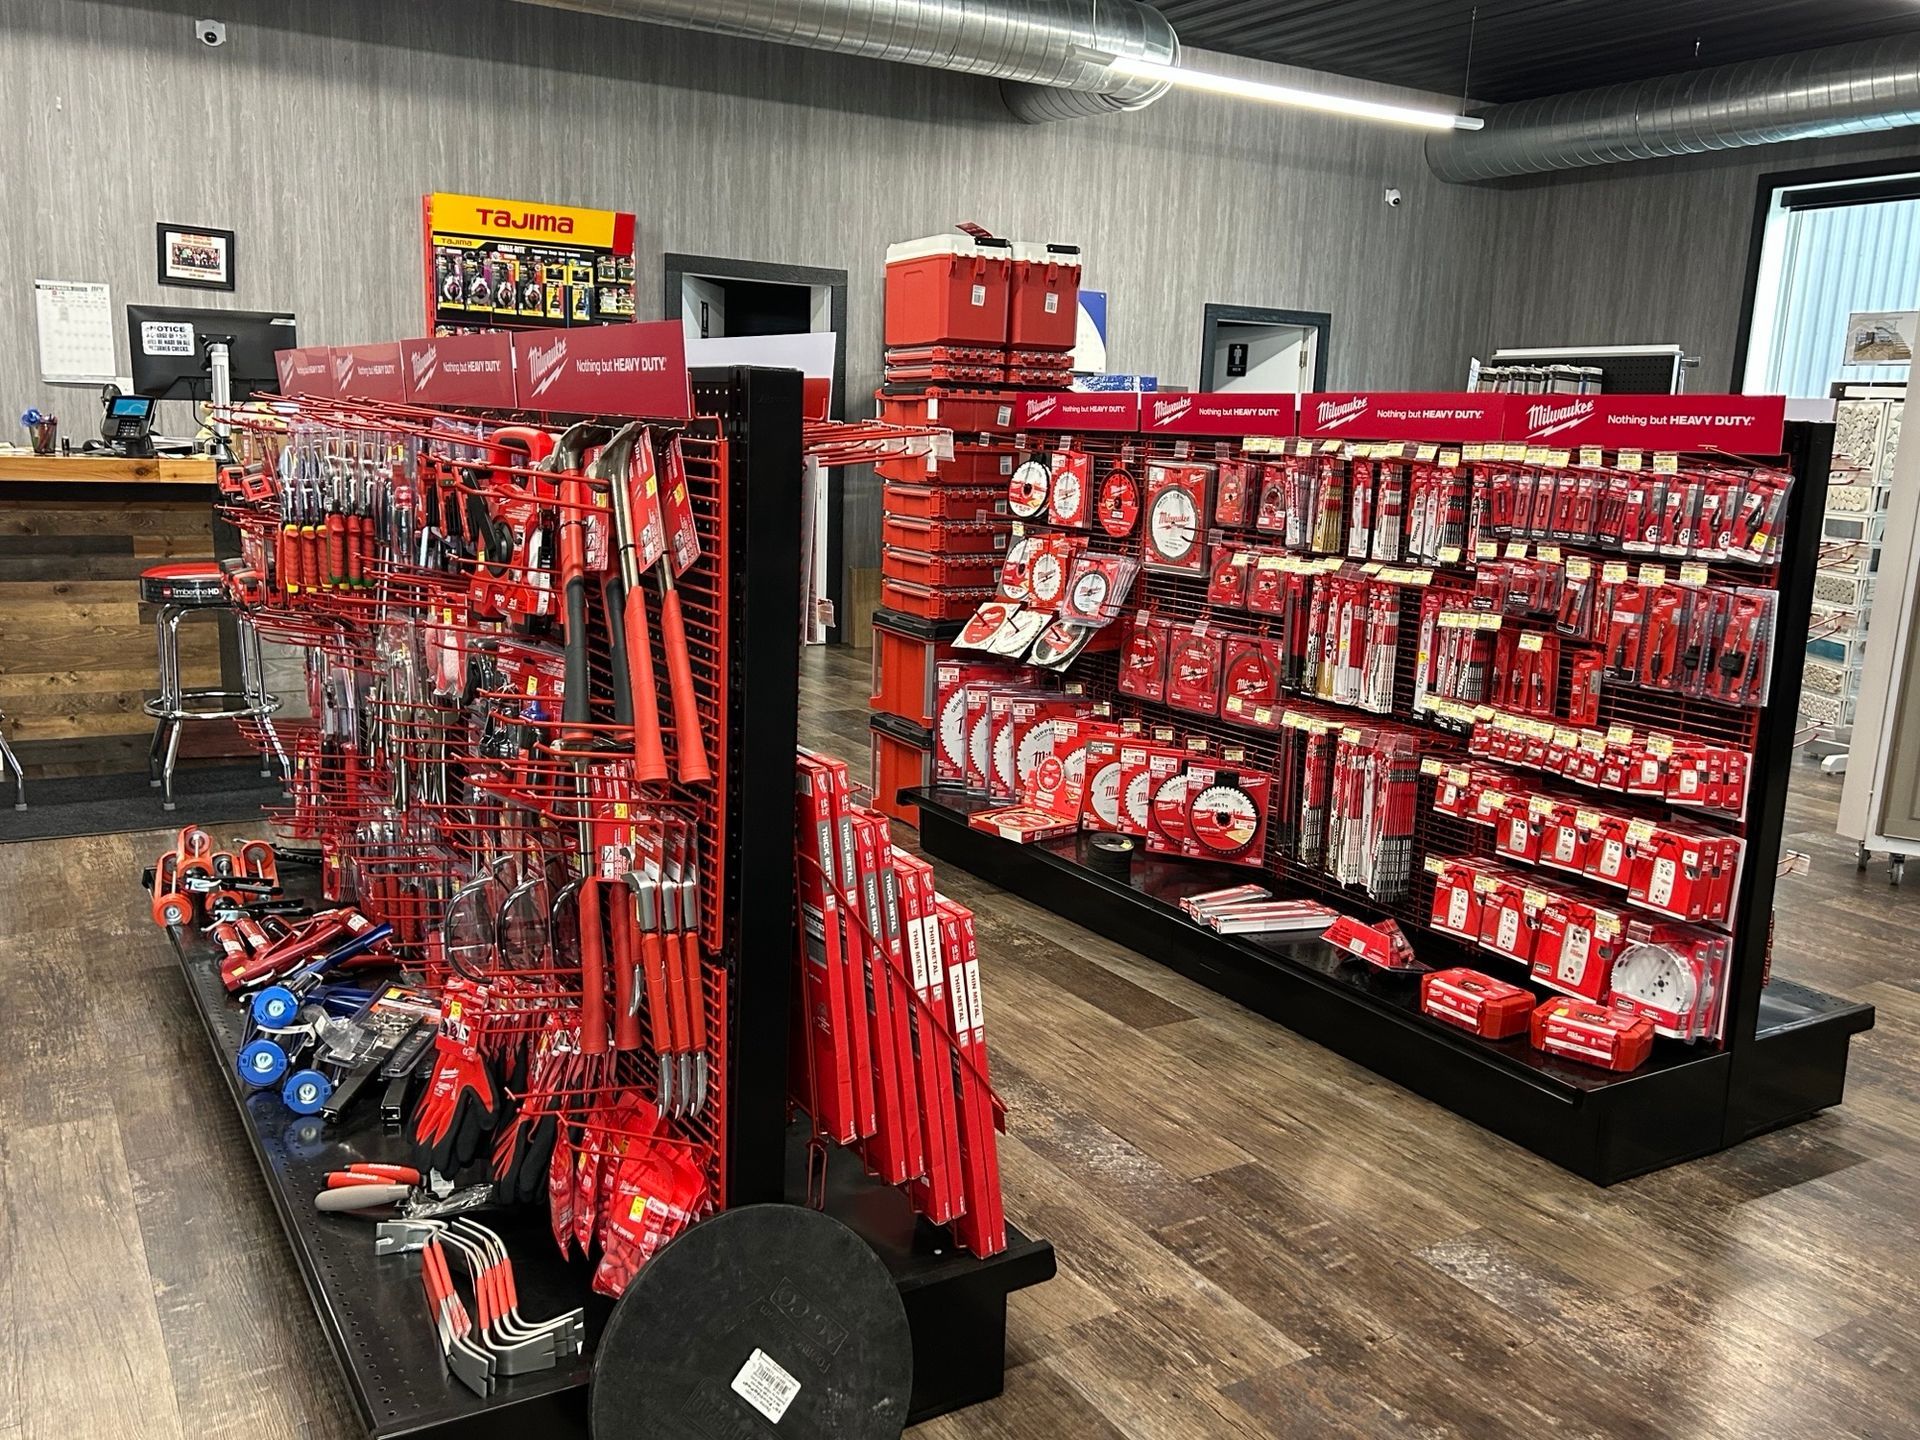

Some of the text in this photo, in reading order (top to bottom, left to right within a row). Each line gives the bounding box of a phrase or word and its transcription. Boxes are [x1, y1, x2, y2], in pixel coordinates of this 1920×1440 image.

[468, 361, 484, 372] HEAVY
[576, 359, 601, 376] Nothing
[601, 358, 613, 373] but
[614, 358, 640, 372] HEAVY
[1062, 405, 1080, 414] Nothing
[1090, 405, 1108, 413] HEAVY
[1199, 407, 1221, 417] Nothing
[1222, 408, 1233, 416] but
[1233, 408, 1257, 416] HEAVY
[1316, 396, 1368, 424] Milwaukee
[1377, 409, 1406, 420] Nothing
[1408, 409, 1421, 418] but
[1422, 410, 1453, 419] HEAVY
[1526, 398, 1594, 430] Milwaukee
[1608, 414, 1647, 426] Nothing
[1650, 414, 1667, 425] but
[1670, 415, 1711, 425] HEAVY
[821, 826, 831, 856] THICK
[843, 822, 854, 883] THICK METAL
[868, 879, 879, 938] THICK METAL
[886, 874, 897, 932] THICK METAL
[912, 928, 923, 981] THIN METAL
[928, 924, 939, 976] THIN METAL
[954, 974, 965, 1023] THIN METAL
[972, 992, 980, 1019] METAL
